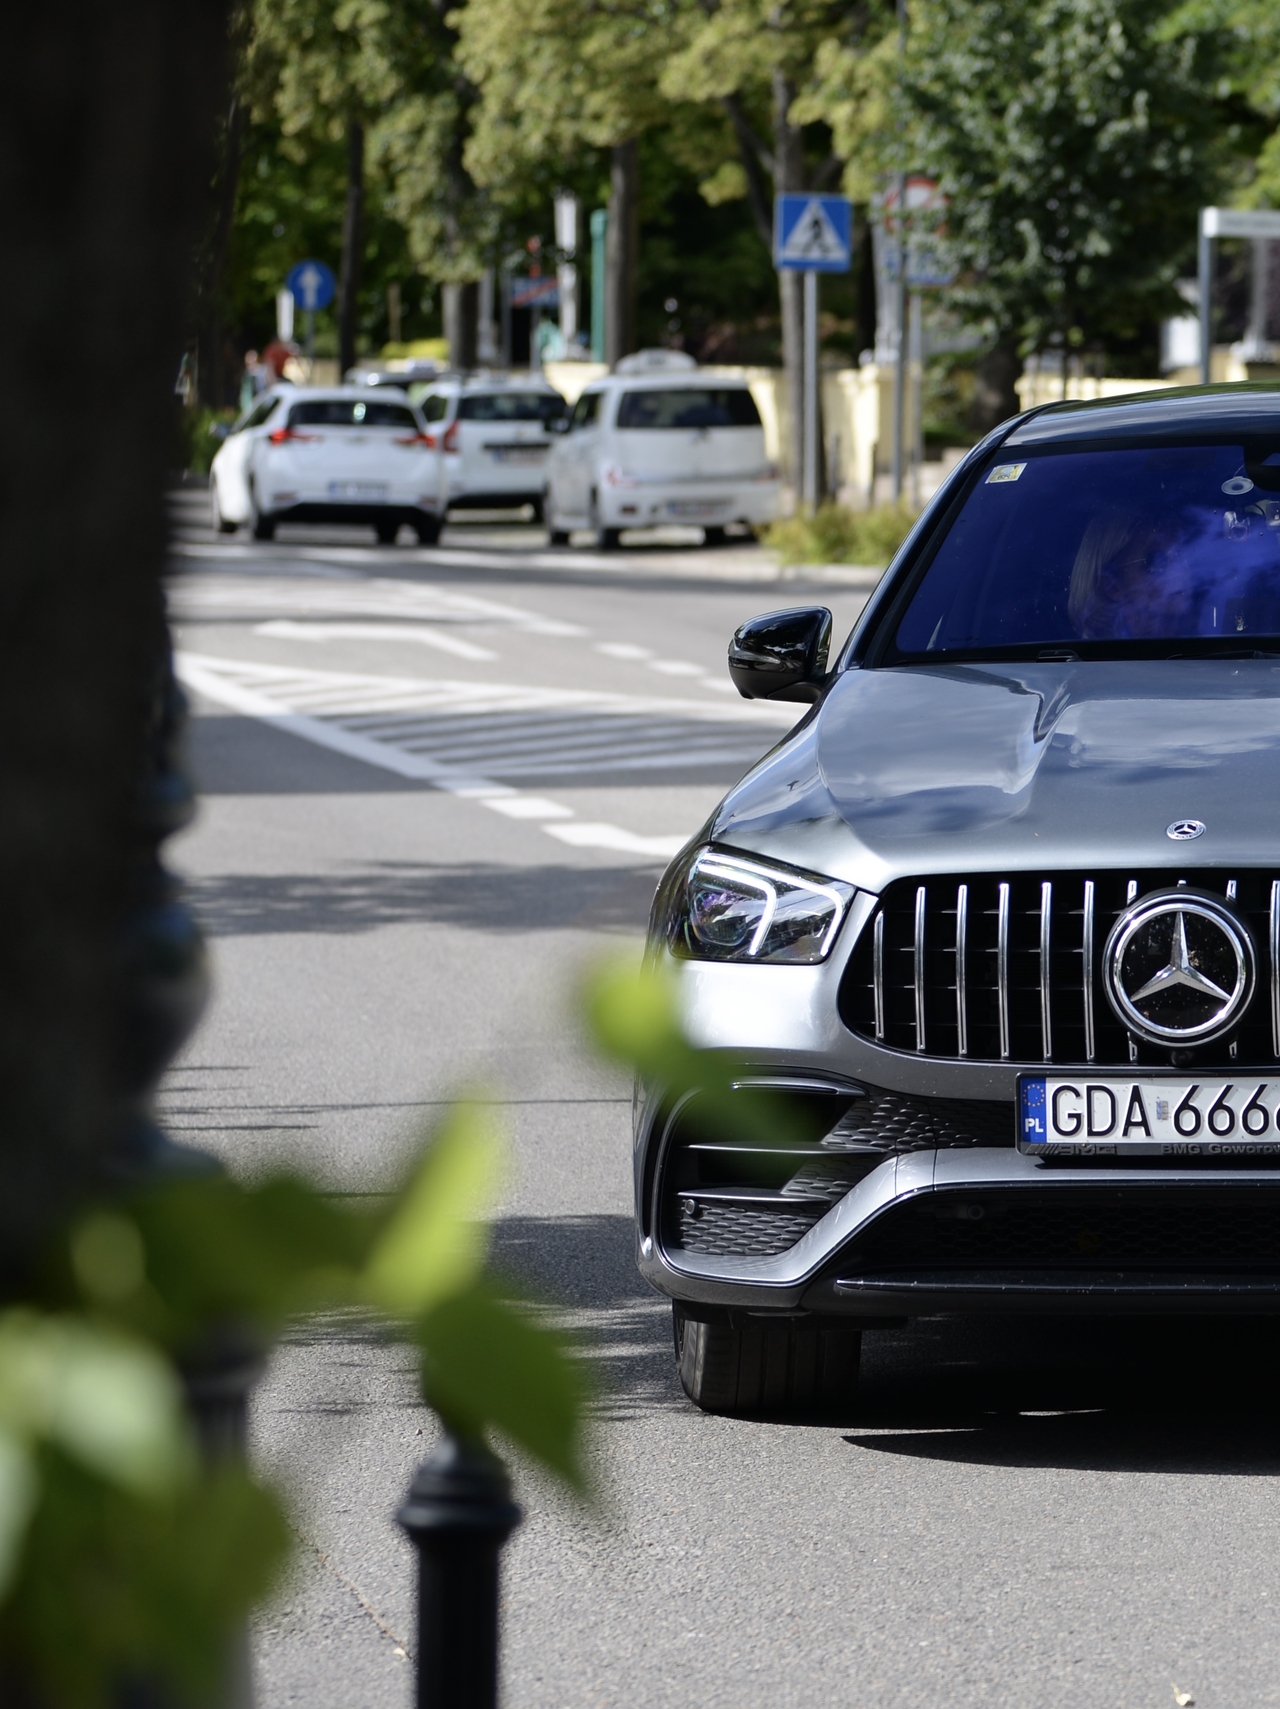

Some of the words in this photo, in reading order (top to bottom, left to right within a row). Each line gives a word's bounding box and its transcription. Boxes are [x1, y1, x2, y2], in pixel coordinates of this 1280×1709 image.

[1051, 1083, 1152, 1137] GDA
[1025, 1118, 1044, 1134] PL
[1160, 1143, 1201, 1155] BMG
